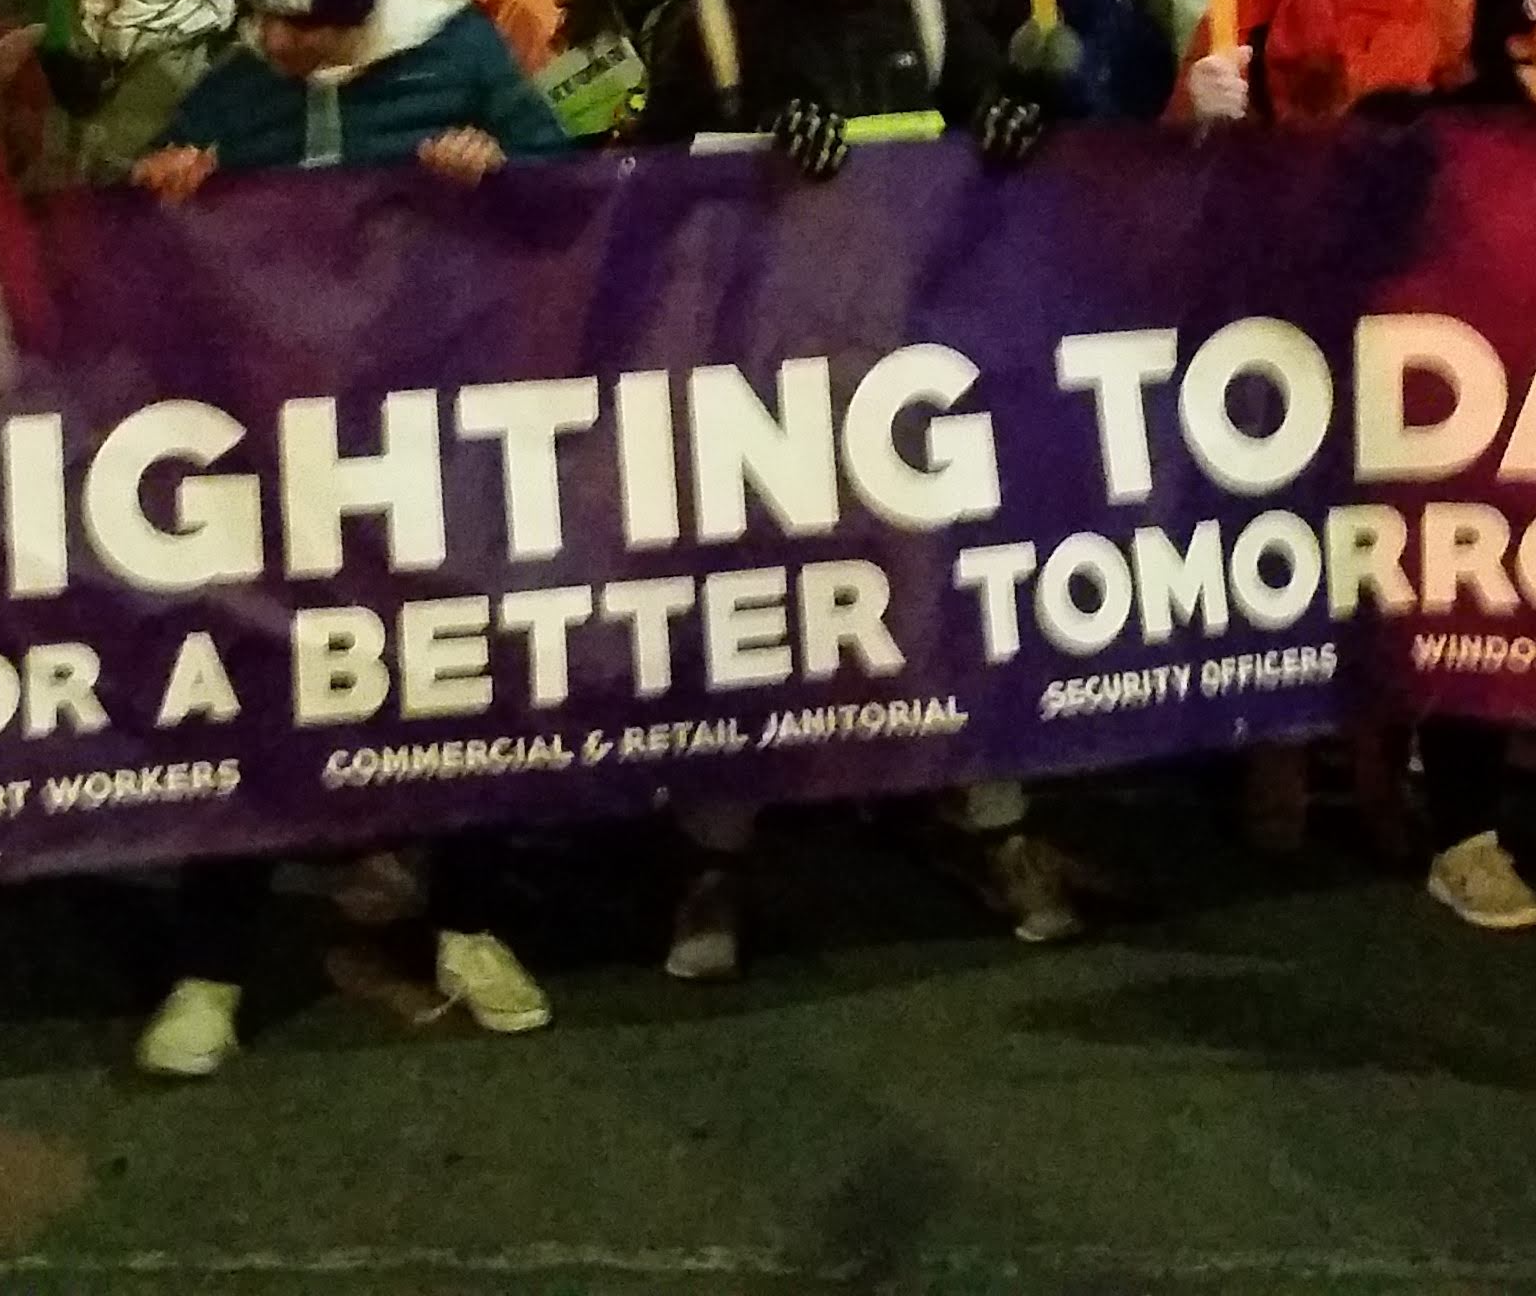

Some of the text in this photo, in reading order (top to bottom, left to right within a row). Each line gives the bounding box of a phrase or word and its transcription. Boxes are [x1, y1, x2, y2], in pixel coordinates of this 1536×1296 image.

[41, 757, 243, 816] WORKERS
[322, 730, 574, 790] COMMERCIAL
[581, 727, 615, 767] &
[616, 716, 749, 762] RETAIL
[757, 694, 970, 750] JANITORIAL
[1039, 661, 1192, 724] SECURITY
[1200, 640, 1339, 702] OFFICERS
[156, 631, 243, 728] A
[292, 558, 908, 729] BETTER
